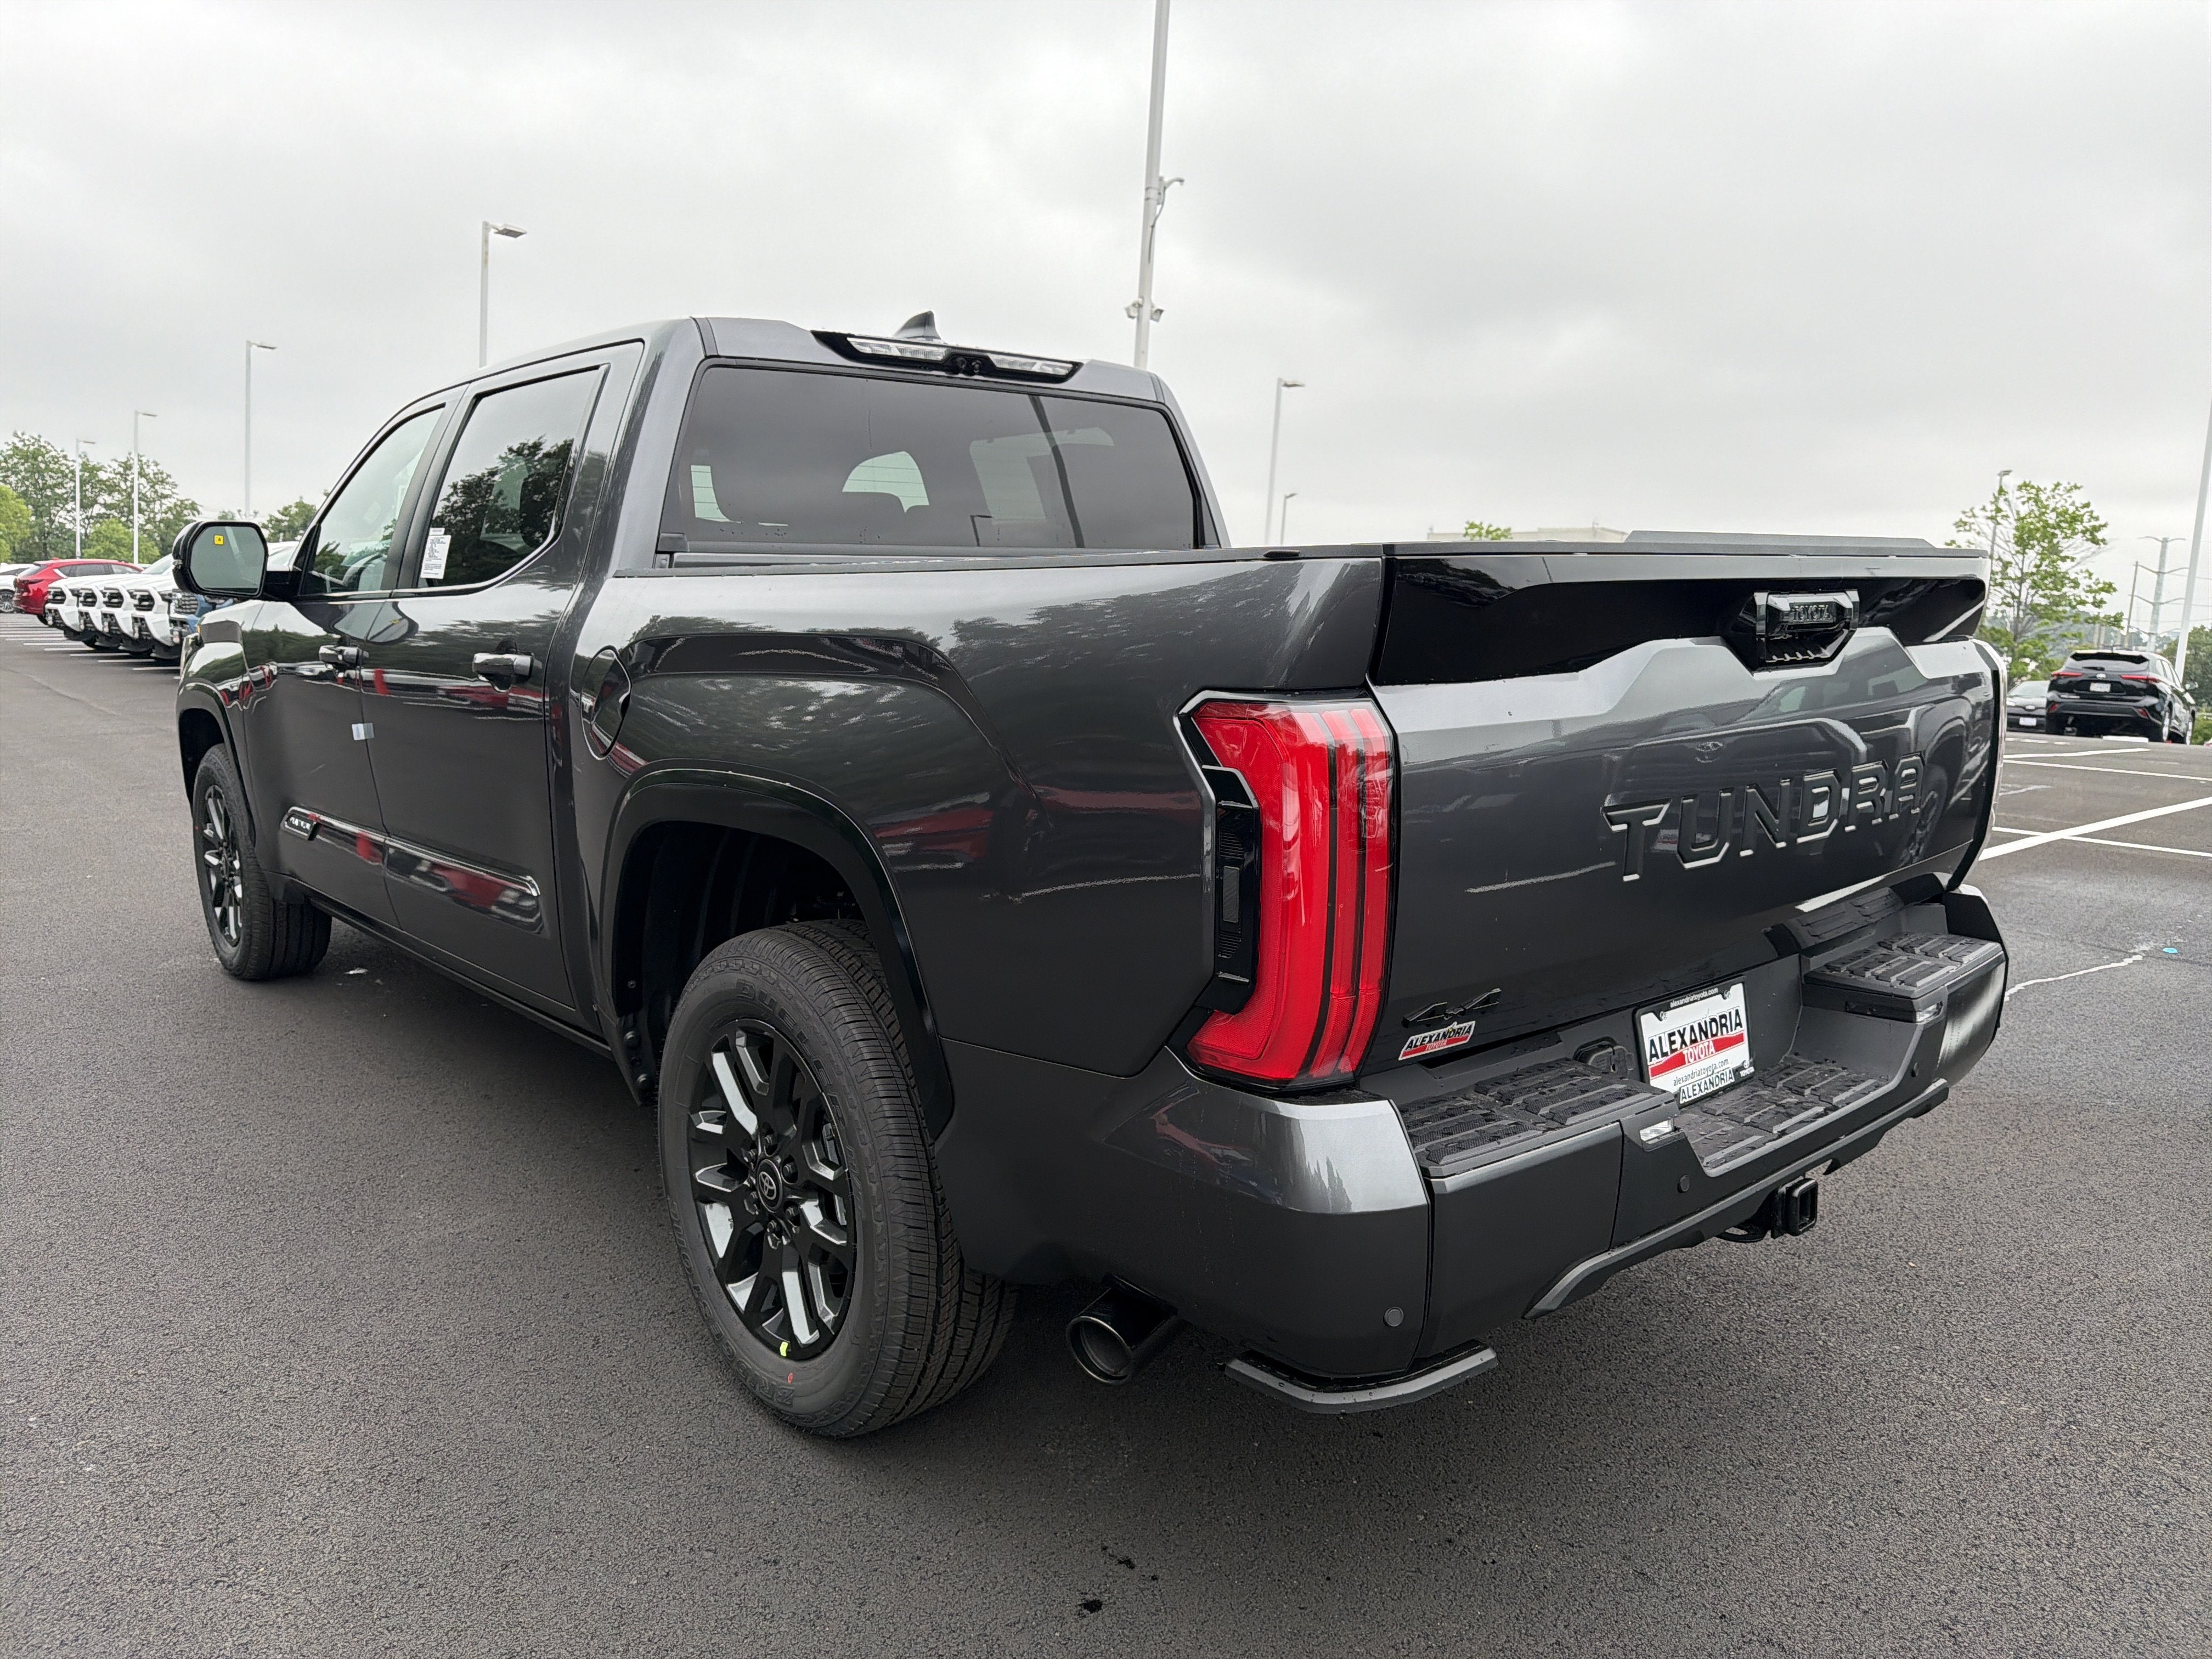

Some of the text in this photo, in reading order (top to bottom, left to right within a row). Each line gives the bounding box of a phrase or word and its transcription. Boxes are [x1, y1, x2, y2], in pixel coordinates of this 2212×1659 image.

[1792, 605, 1831, 621] TOYOTA
[1601, 752, 1926, 882] TUNDRA
[1670, 988, 1718, 1008] alexandriatoyota.com
[1404, 1024, 1473, 1051] ALEXANDRIA
[1426, 1039, 1448, 1051] TOYOTA
[1649, 1008, 1743, 1063] ALEXANDRIA
[1683, 1041, 1716, 1065] TOYOTA
[1673, 1058, 1729, 1087] alexandriatoyota.com
[1681, 1069, 1734, 1102] ALEXANDRIA
